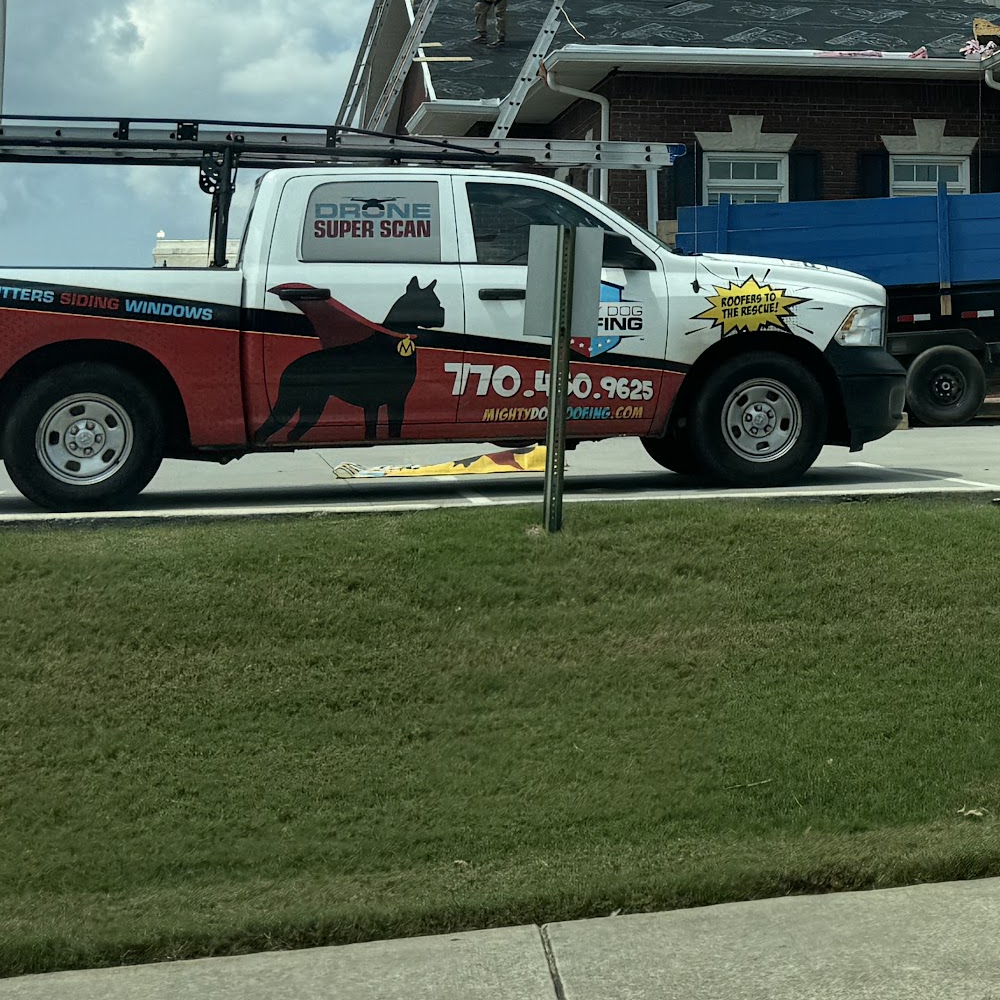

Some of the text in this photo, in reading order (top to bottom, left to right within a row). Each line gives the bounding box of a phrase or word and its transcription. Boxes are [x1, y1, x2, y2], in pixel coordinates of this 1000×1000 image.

[314, 203, 431, 219] DRONE
[314, 220, 431, 238] SUPER SCAN
[60, 292, 120, 310] SIDING
[125, 299, 213, 321] WINDOWS
[721, 292, 777, 307] ROOFERS TO
[607, 305, 643, 316] DOG
[722, 302, 779, 319] THE RESCUE!
[444, 363, 654, 400] 770.40.9625
